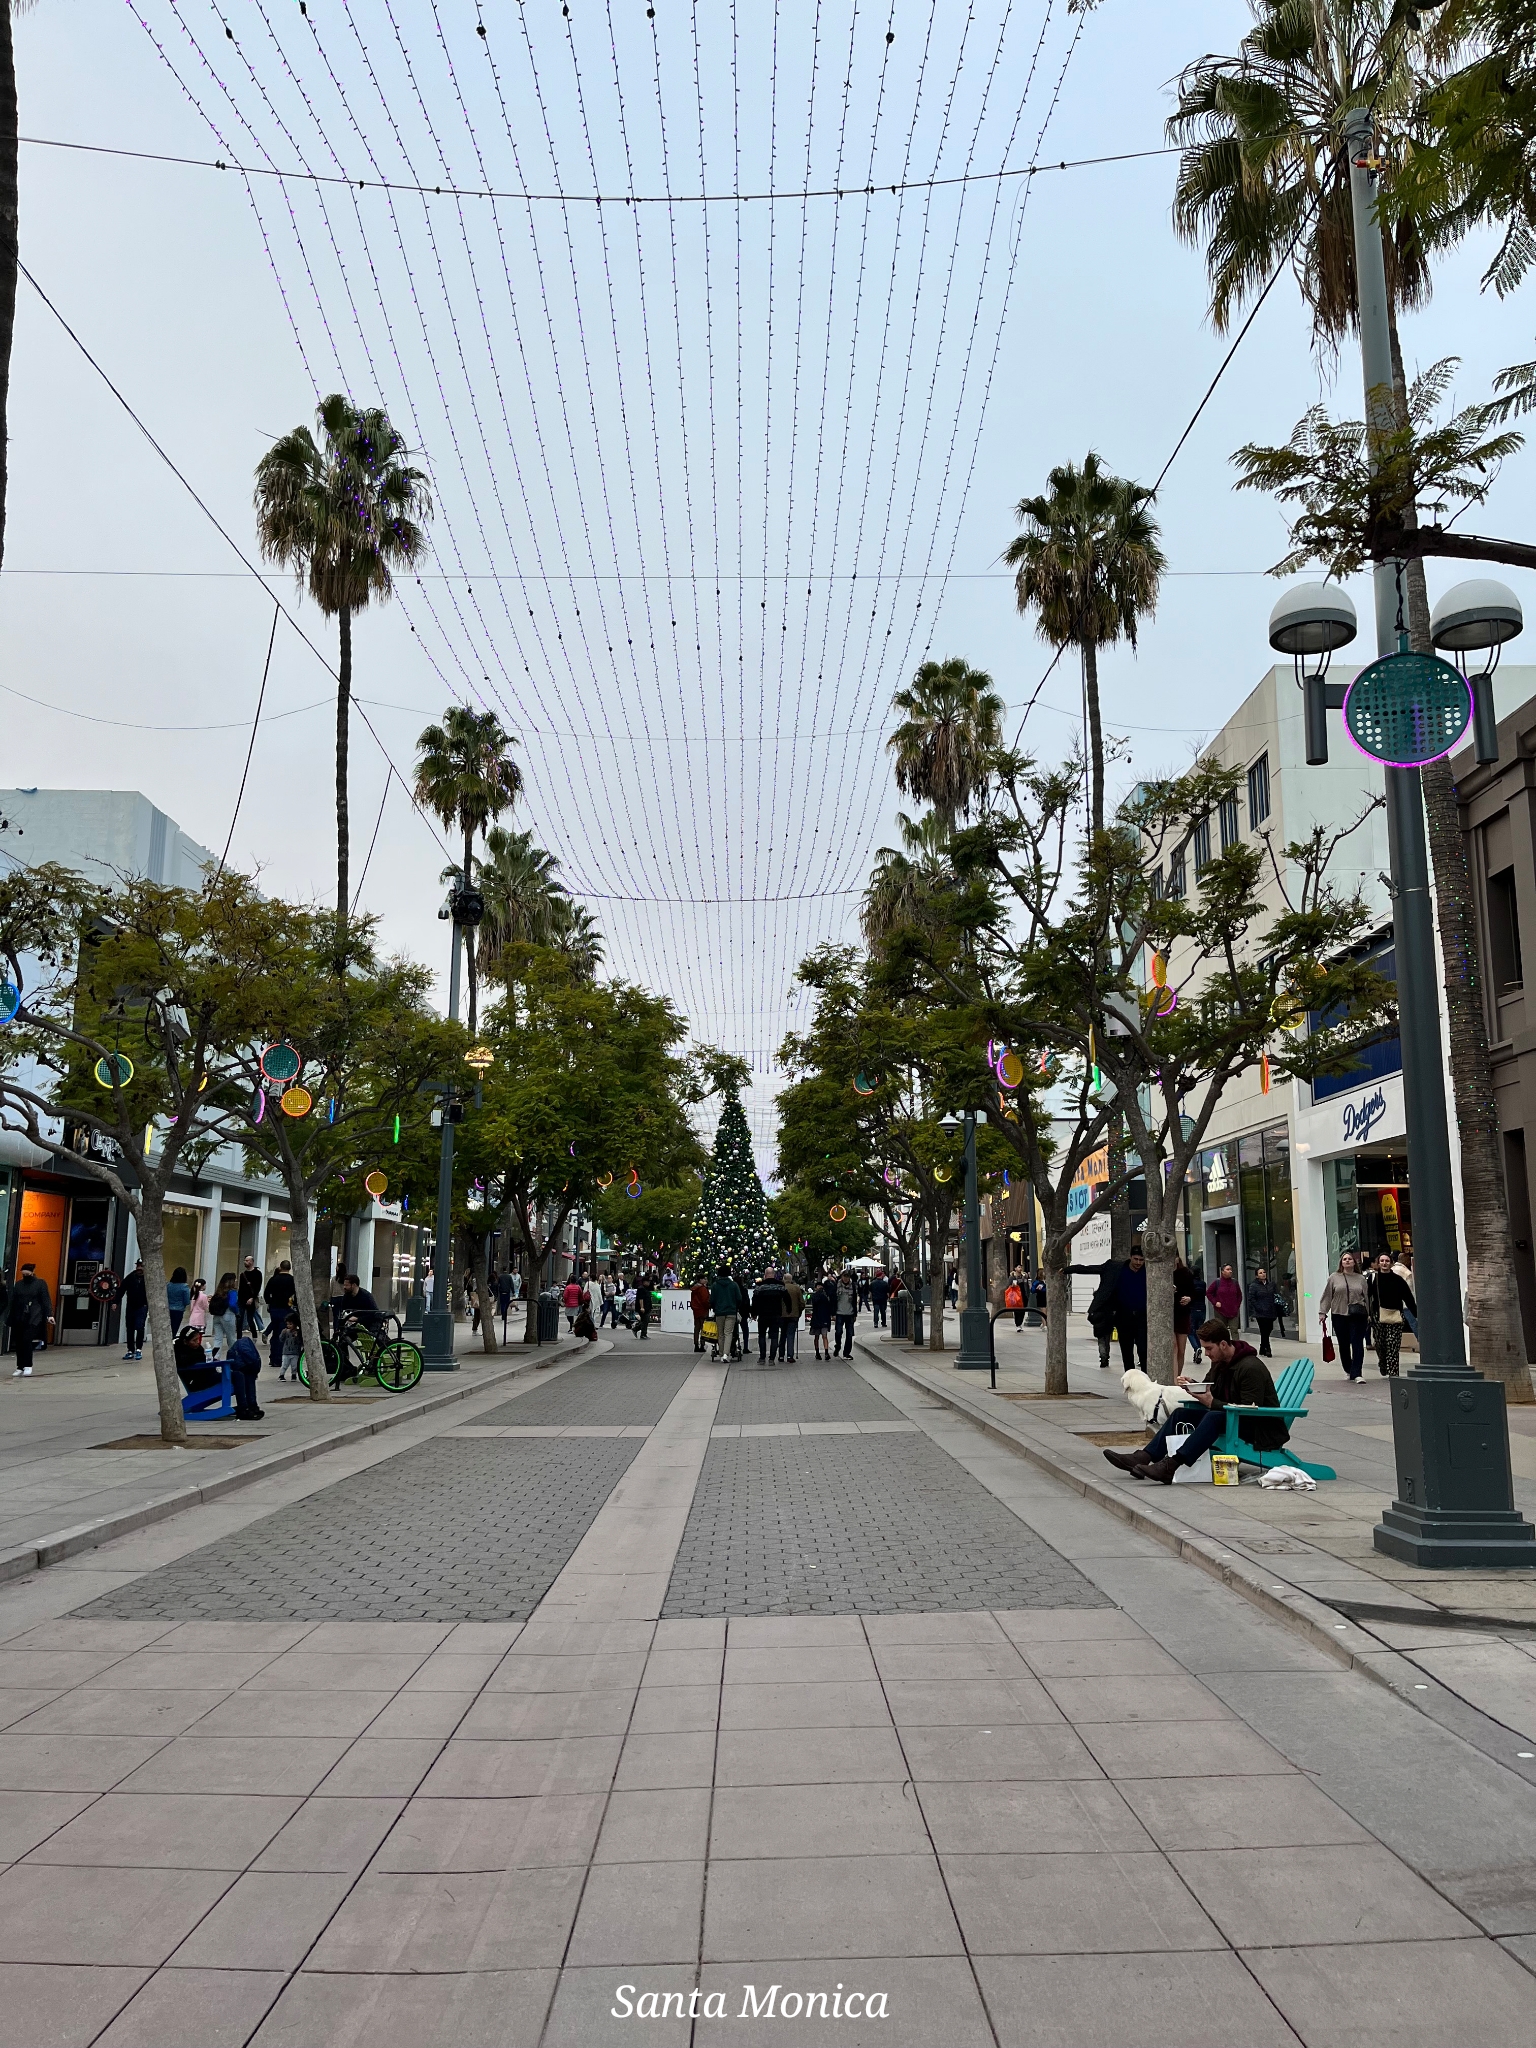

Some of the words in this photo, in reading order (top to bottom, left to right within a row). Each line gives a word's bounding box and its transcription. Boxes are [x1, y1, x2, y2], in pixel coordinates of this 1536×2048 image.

[1343, 1086, 1386, 1142] Dodgers
[1087, 1156, 1107, 1177] Moni
[672, 1300, 692, 1310] HAP
